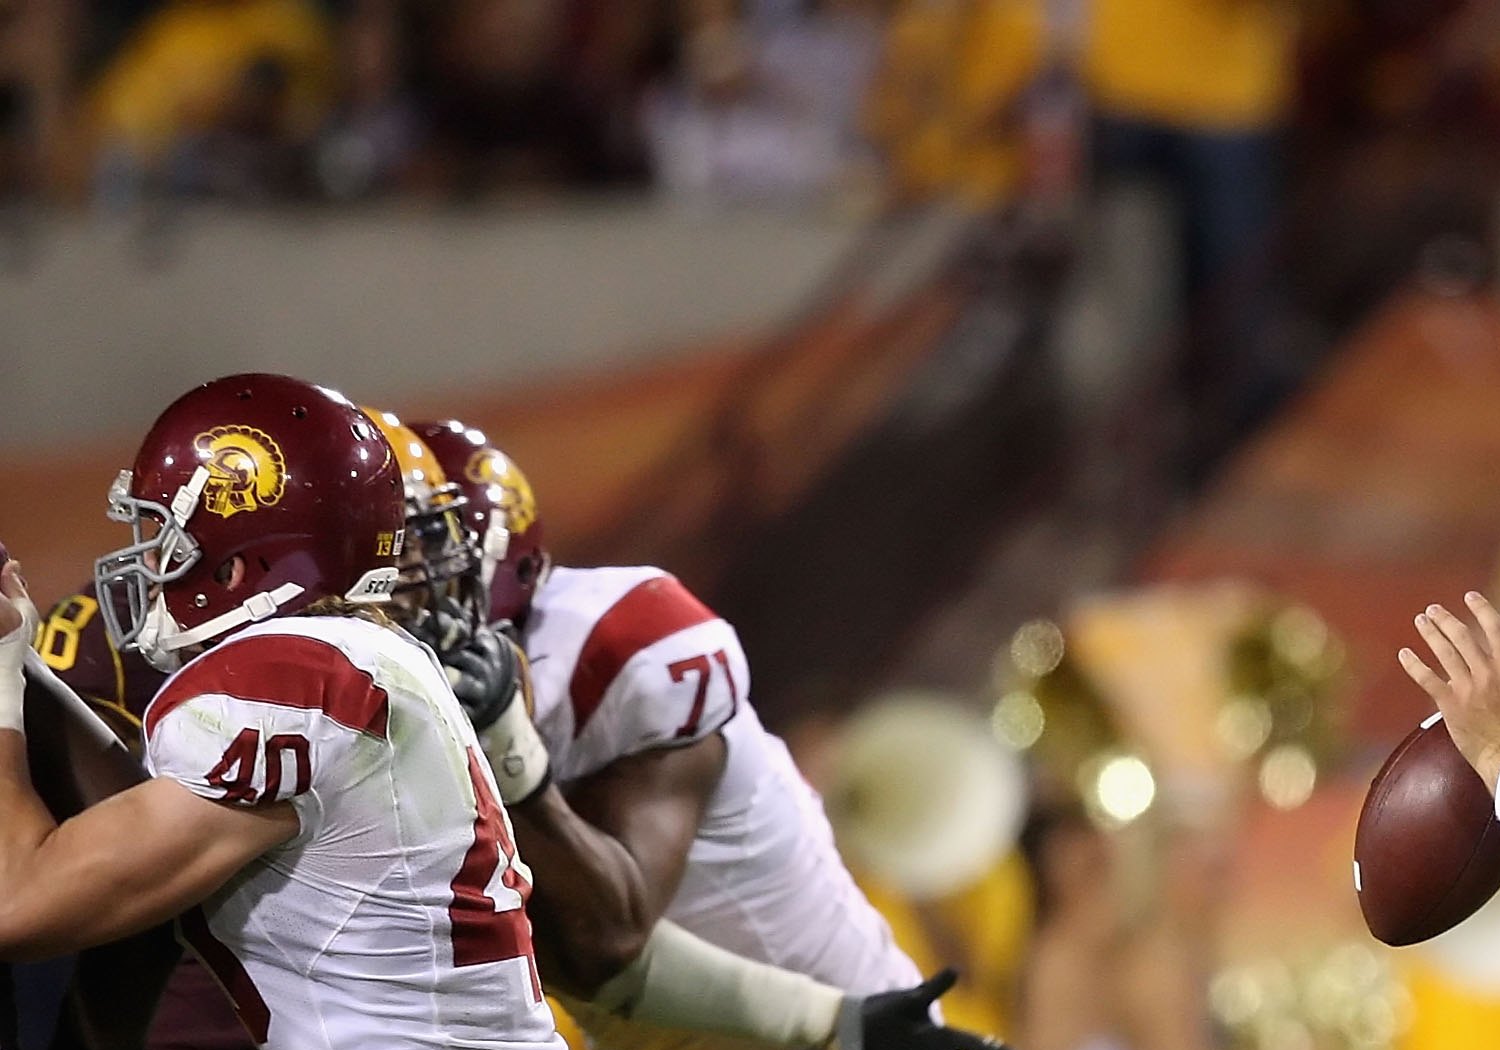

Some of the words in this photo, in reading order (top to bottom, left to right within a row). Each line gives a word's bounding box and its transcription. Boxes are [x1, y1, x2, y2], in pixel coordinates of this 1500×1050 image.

[376, 541, 393, 556] 13
[34, 594, 99, 671] 8
[667, 649, 737, 738] 71
[203, 727, 311, 802] 40
